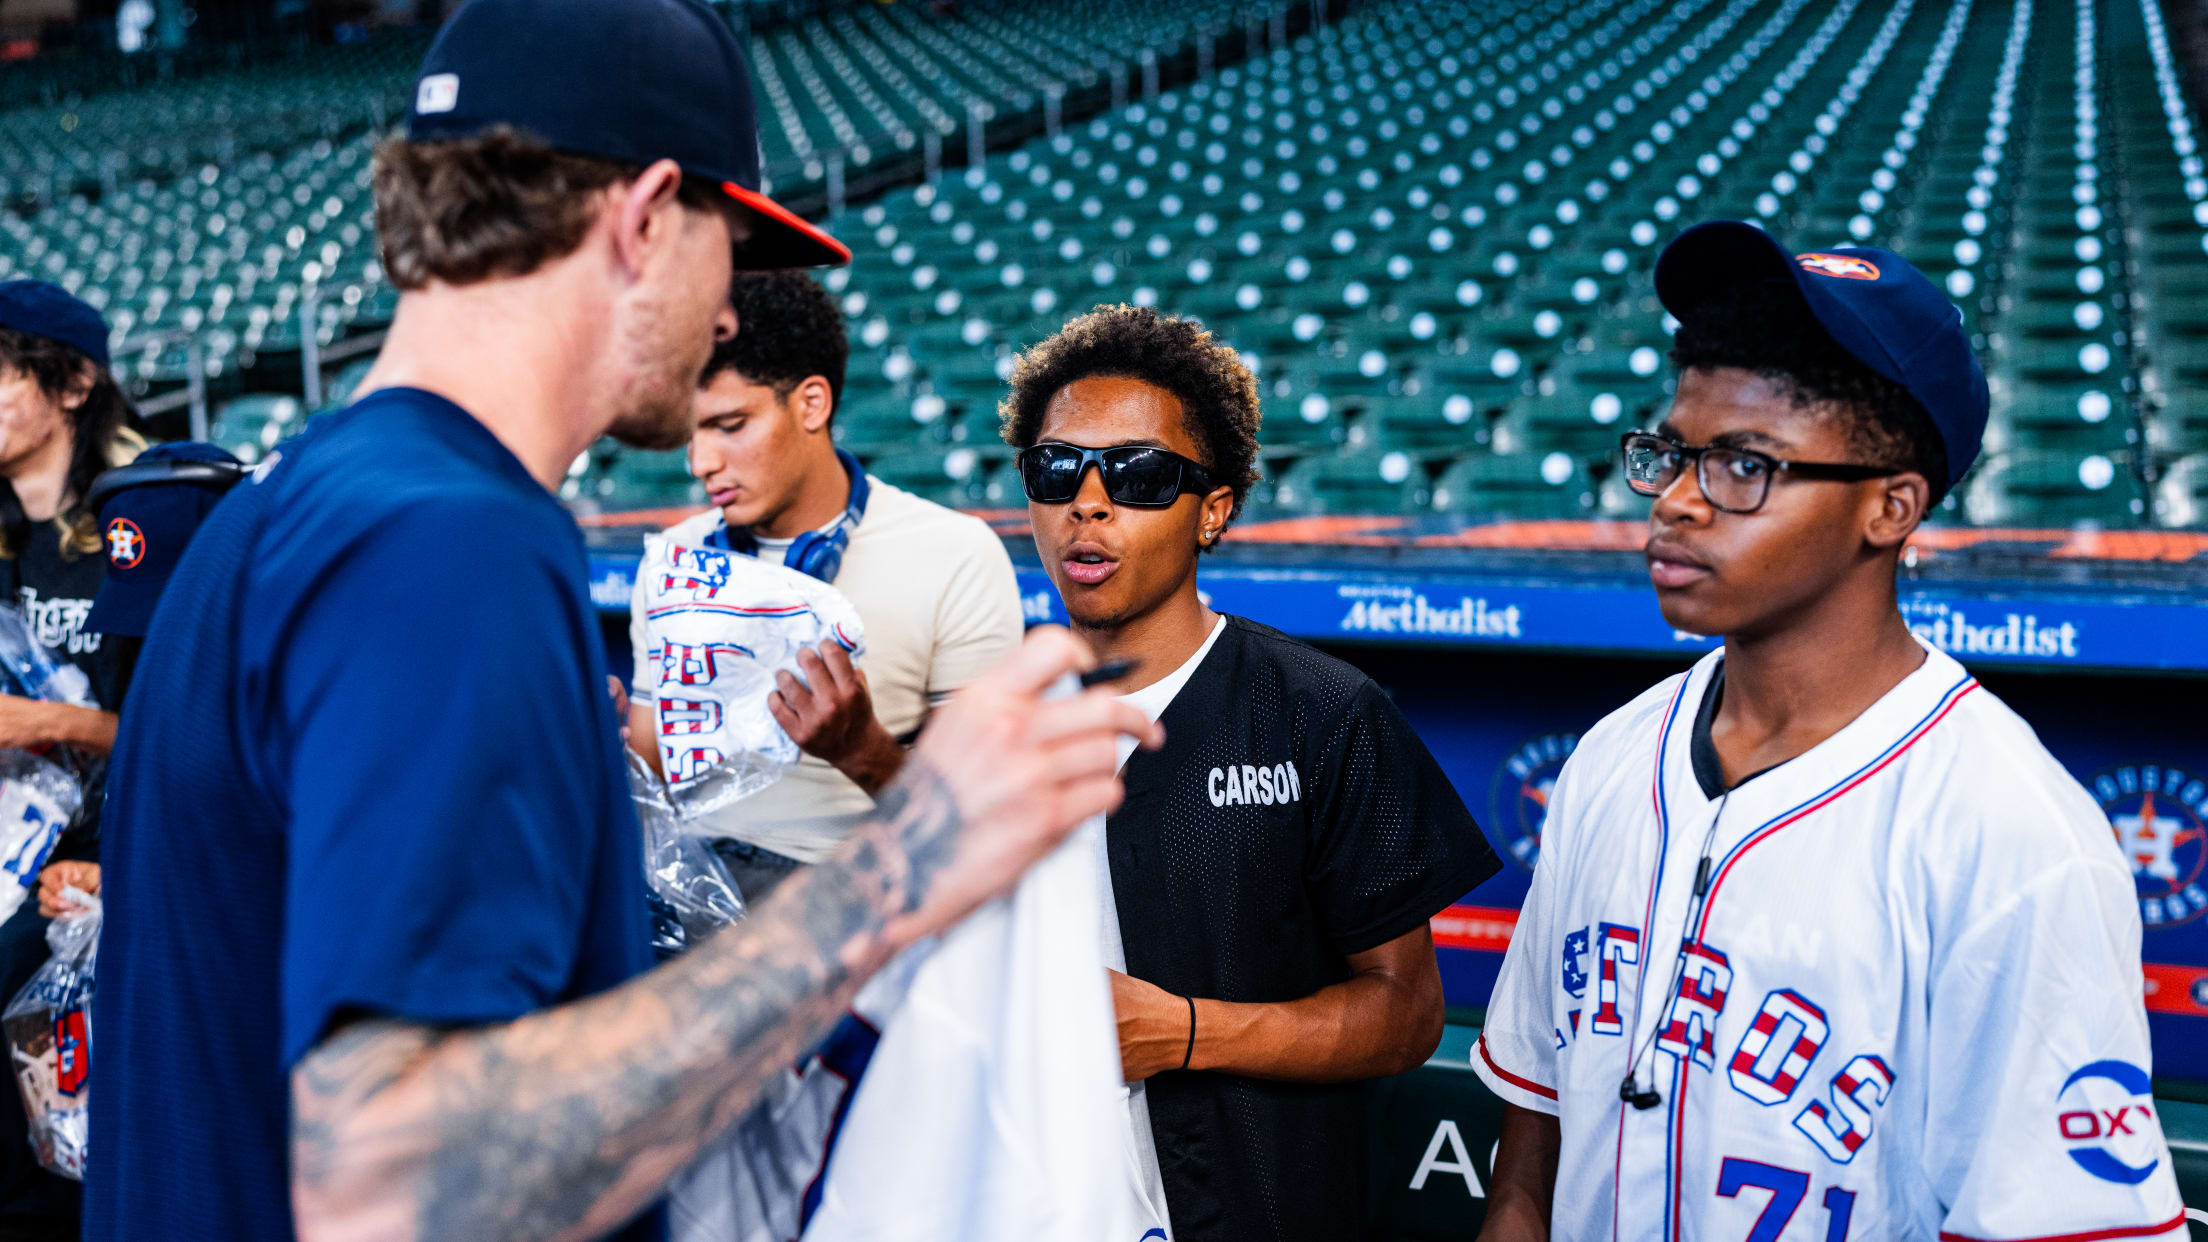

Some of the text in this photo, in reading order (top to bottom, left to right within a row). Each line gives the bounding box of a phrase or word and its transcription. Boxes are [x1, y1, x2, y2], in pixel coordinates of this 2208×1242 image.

[109, 528, 136, 560] H
[1341, 594, 1522, 638] Methodist
[658, 543, 732, 784] STROS
[1207, 760, 1302, 808] CARSON
[1556, 920, 1898, 1166] STROS
[1409, 1119, 1500, 1199] A
[1715, 1156, 1858, 1242] 71
